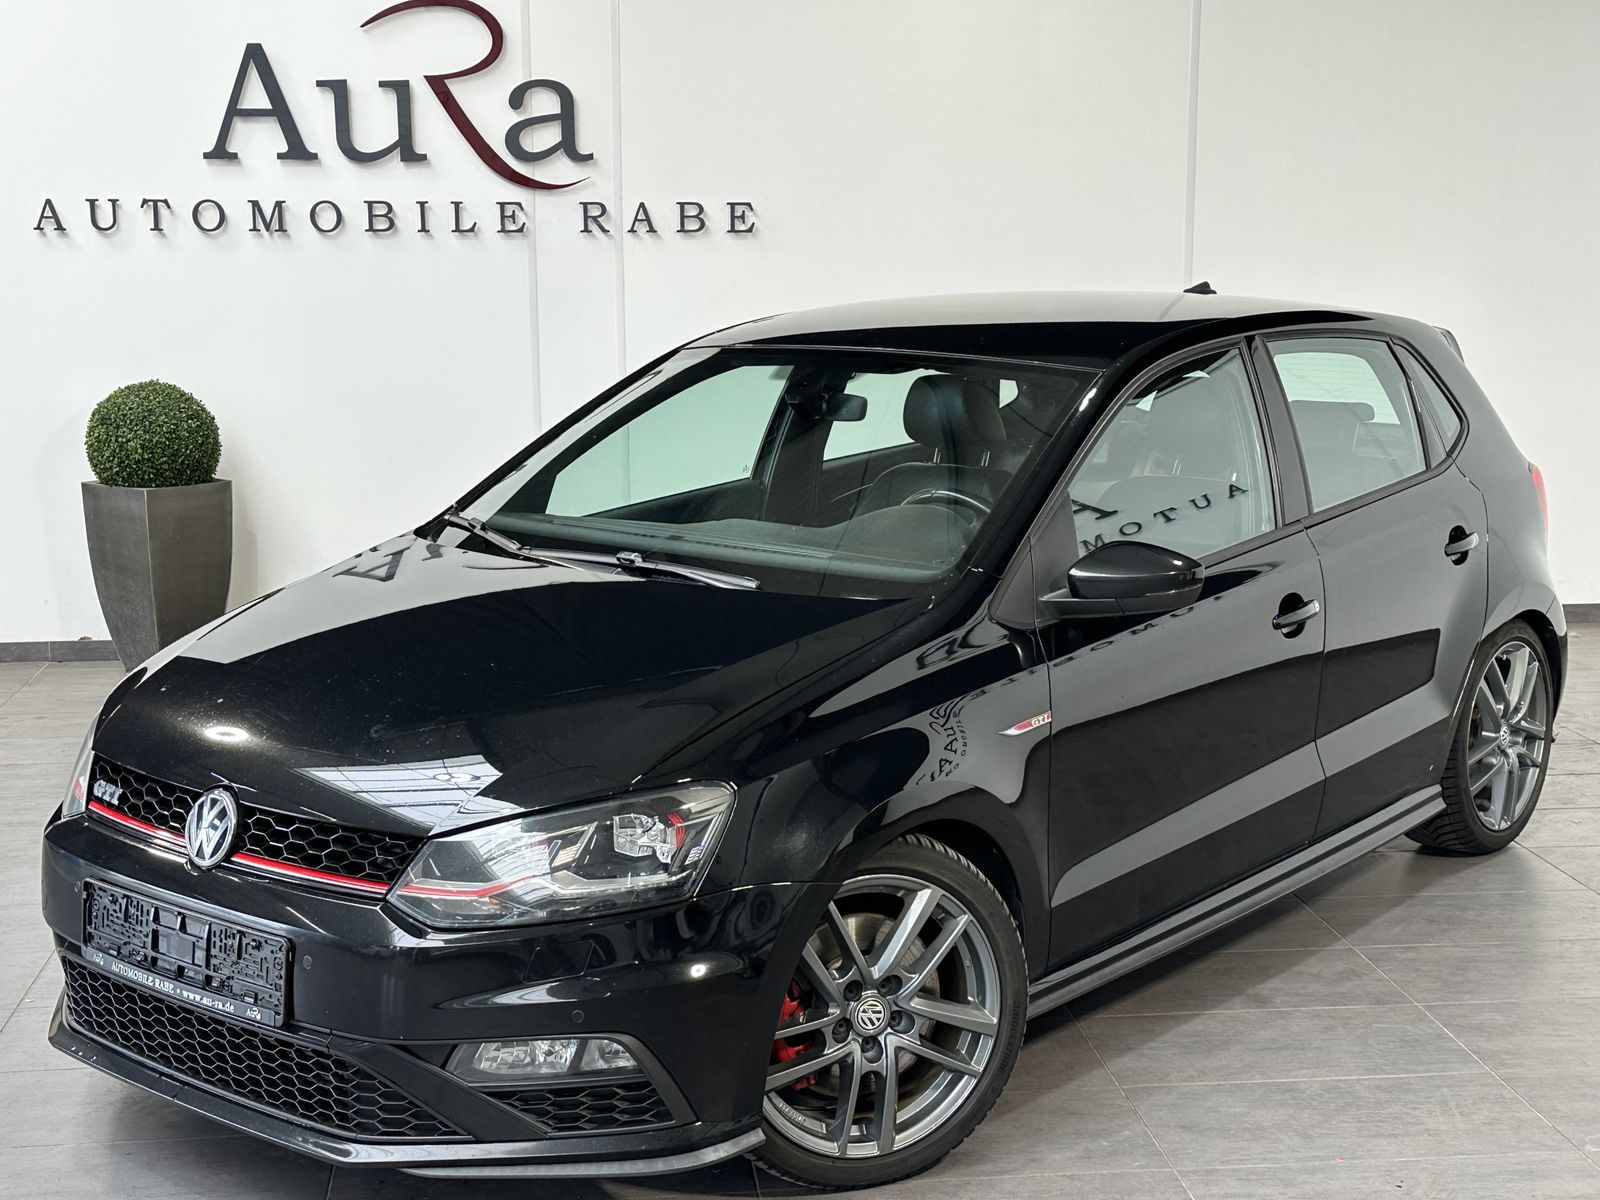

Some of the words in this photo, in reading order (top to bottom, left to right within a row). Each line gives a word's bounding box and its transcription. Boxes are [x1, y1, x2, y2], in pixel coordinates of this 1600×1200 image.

[34, 198, 526, 234] AUTOMOBILE
[579, 201, 756, 234] RABE
[1032, 711, 1050, 728] GTI
[93, 779, 123, 806] GTI
[112, 961, 154, 986] AUTOMOBILE
[155, 978, 175, 994] RABE
